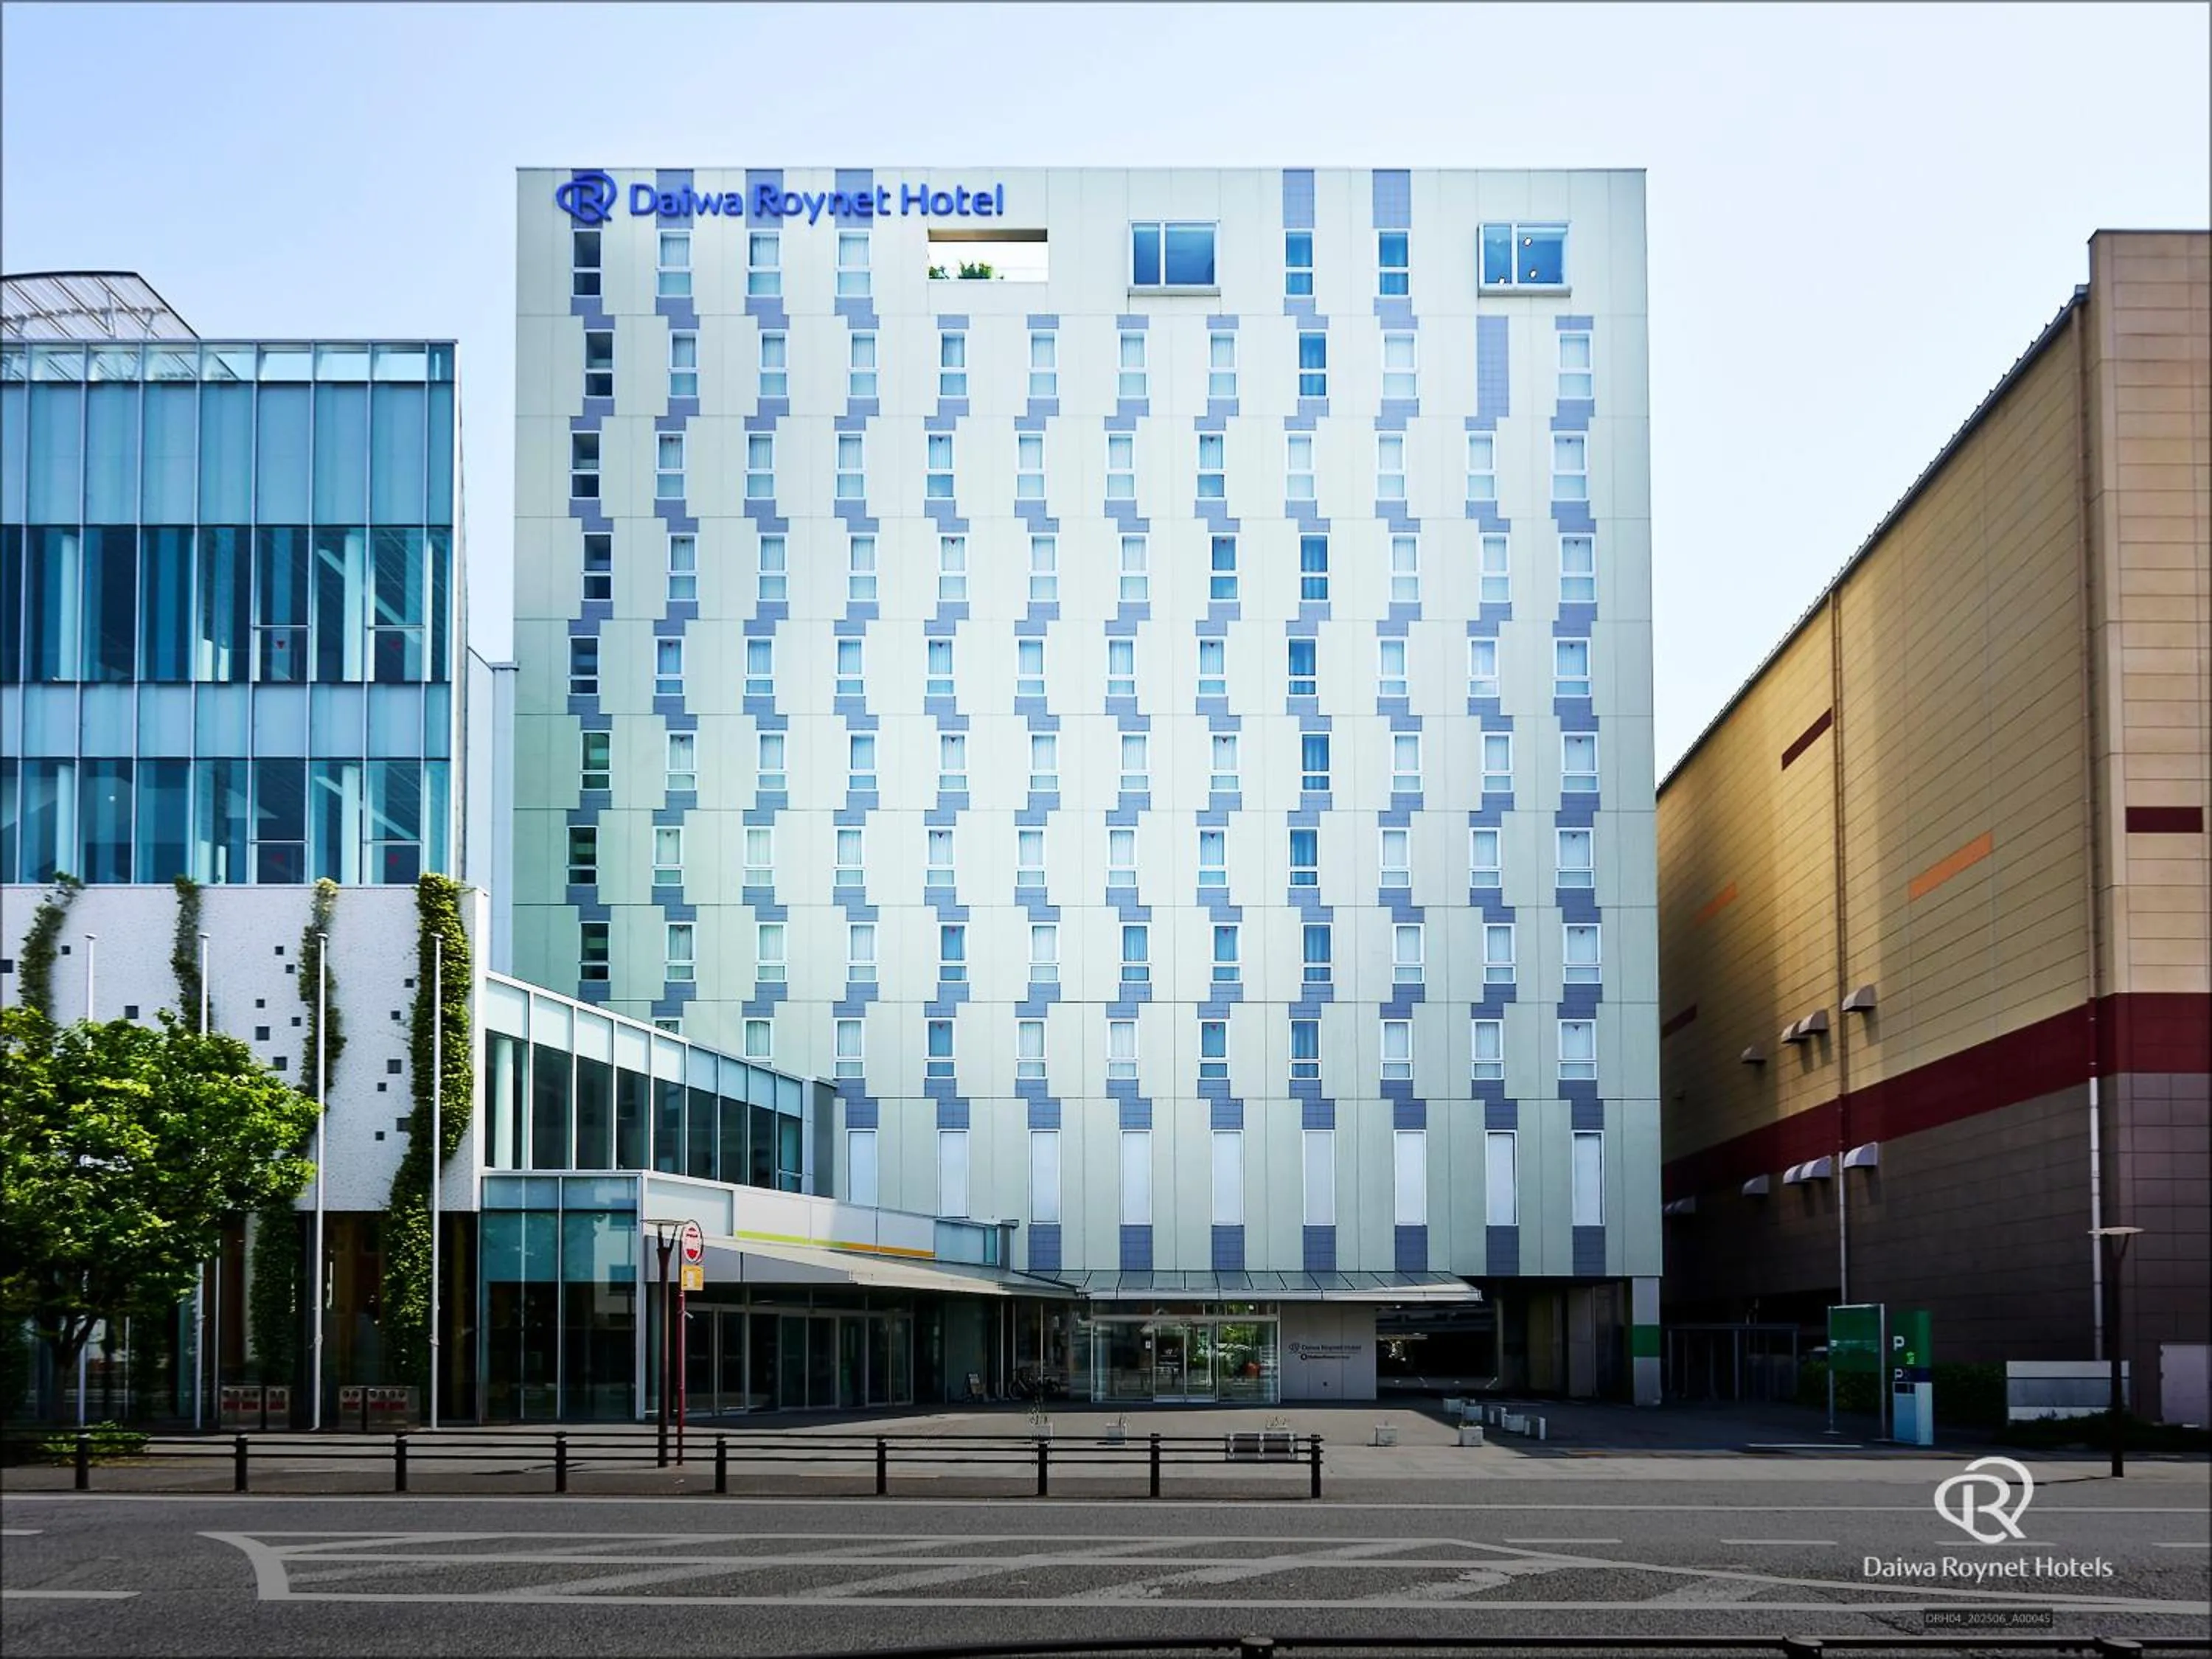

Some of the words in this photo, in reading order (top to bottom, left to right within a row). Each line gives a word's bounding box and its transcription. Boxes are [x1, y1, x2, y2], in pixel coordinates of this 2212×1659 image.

[630, 183, 743, 217] Daiwa
[754, 183, 891, 226] Roynet
[900, 182, 1004, 217] Hotel
[1893, 1335, 1905, 1351] P
[1894, 1368, 1904, 1380] P
